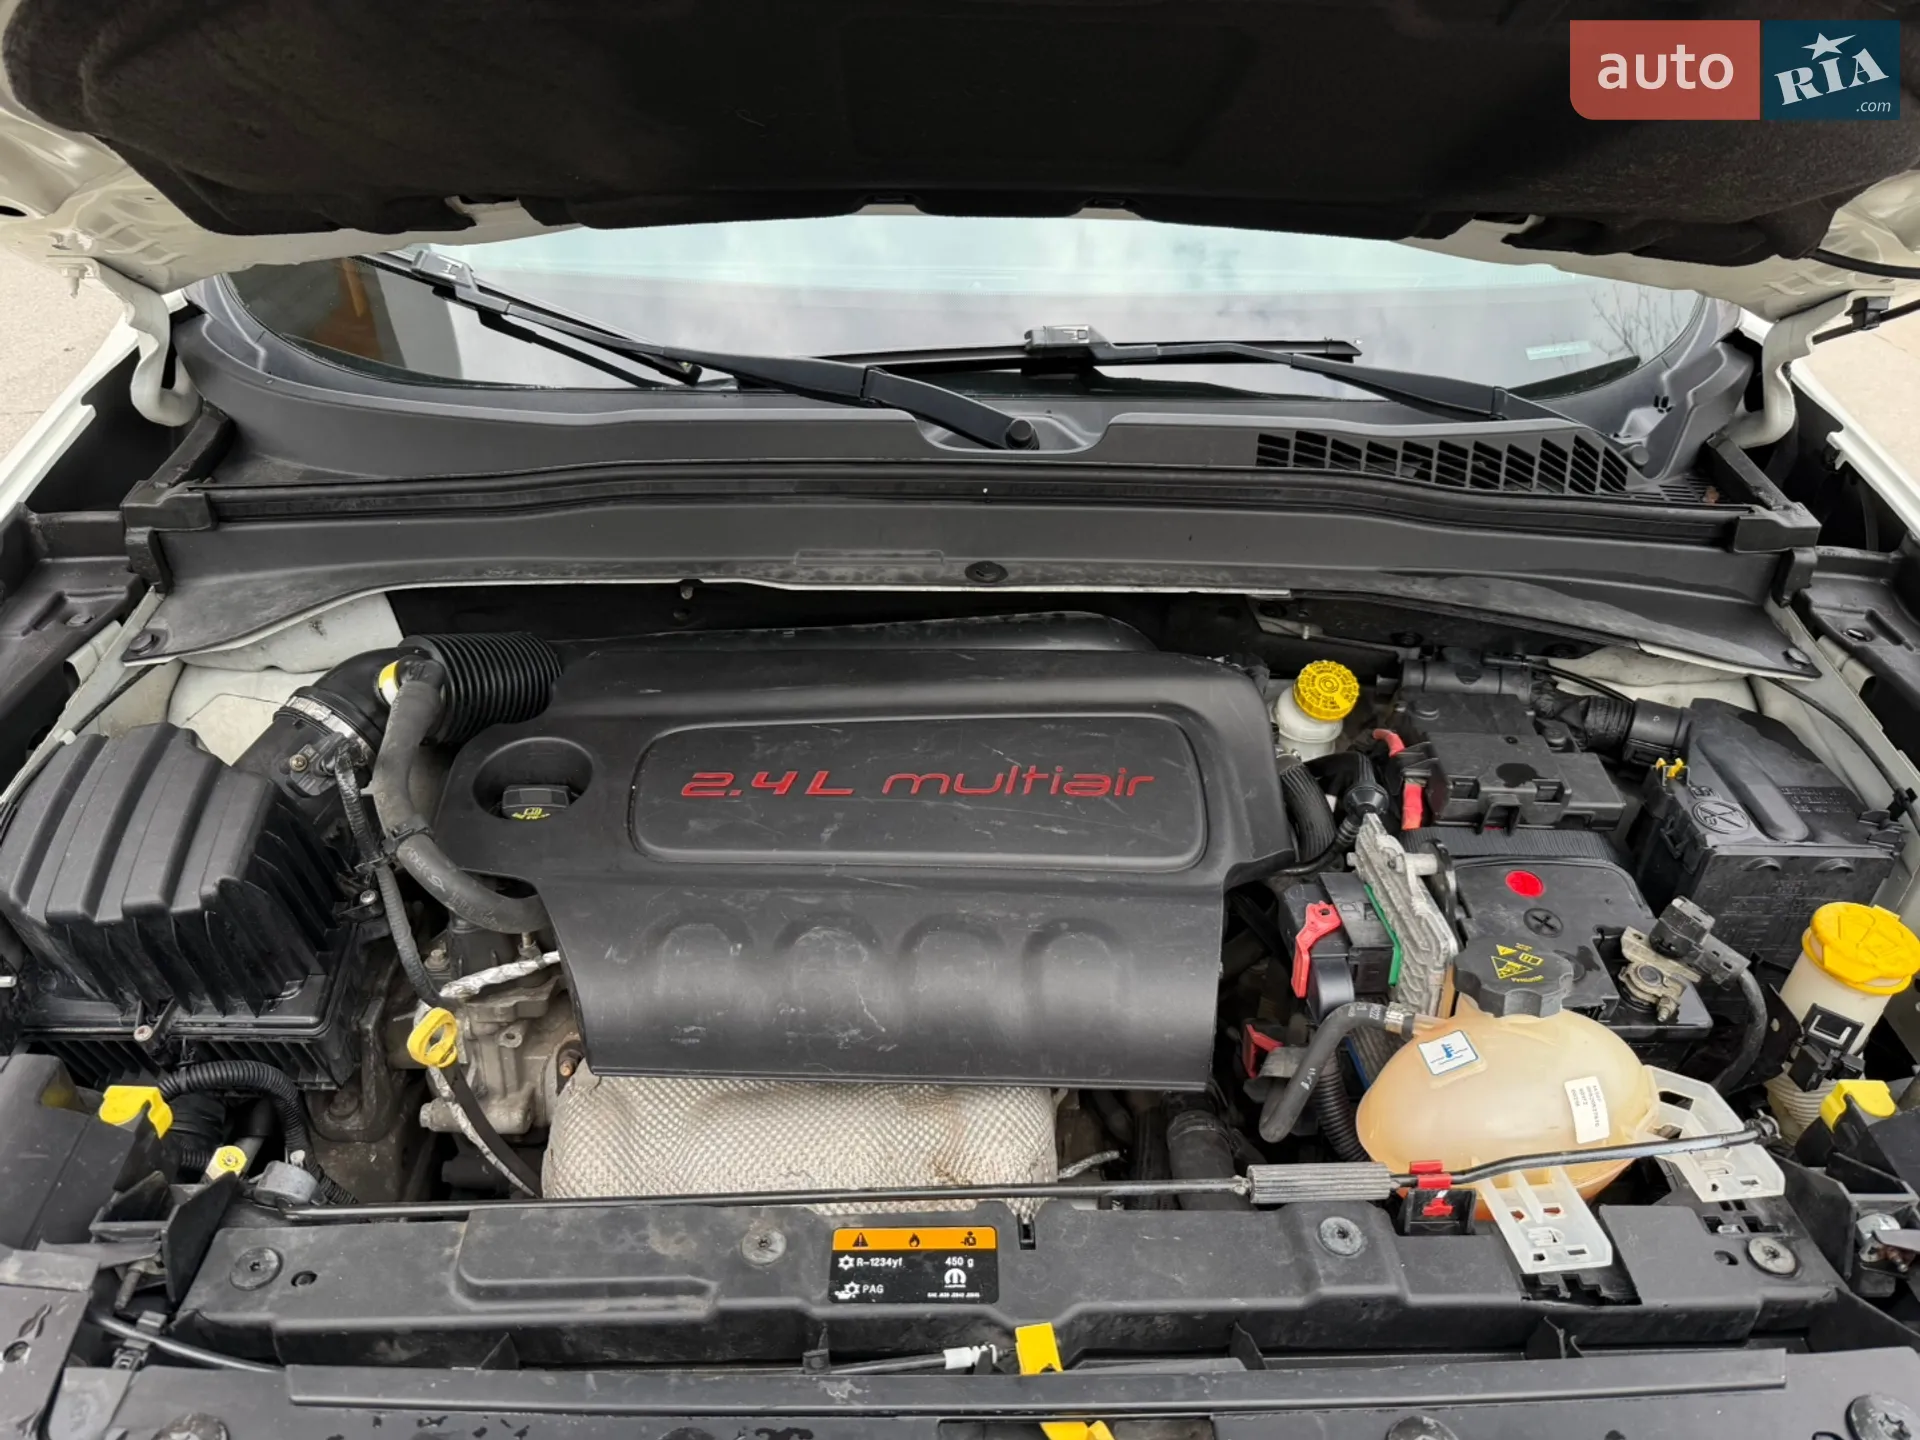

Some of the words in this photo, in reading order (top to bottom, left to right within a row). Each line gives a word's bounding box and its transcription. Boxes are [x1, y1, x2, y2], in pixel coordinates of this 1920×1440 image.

[881, 764, 1155, 797] multiair
[856, 1257, 903, 1268] R-1234yf
[945, 1256, 964, 1266] 450
[967, 1257, 974, 1268] g
[862, 1284, 884, 1294] PAG
